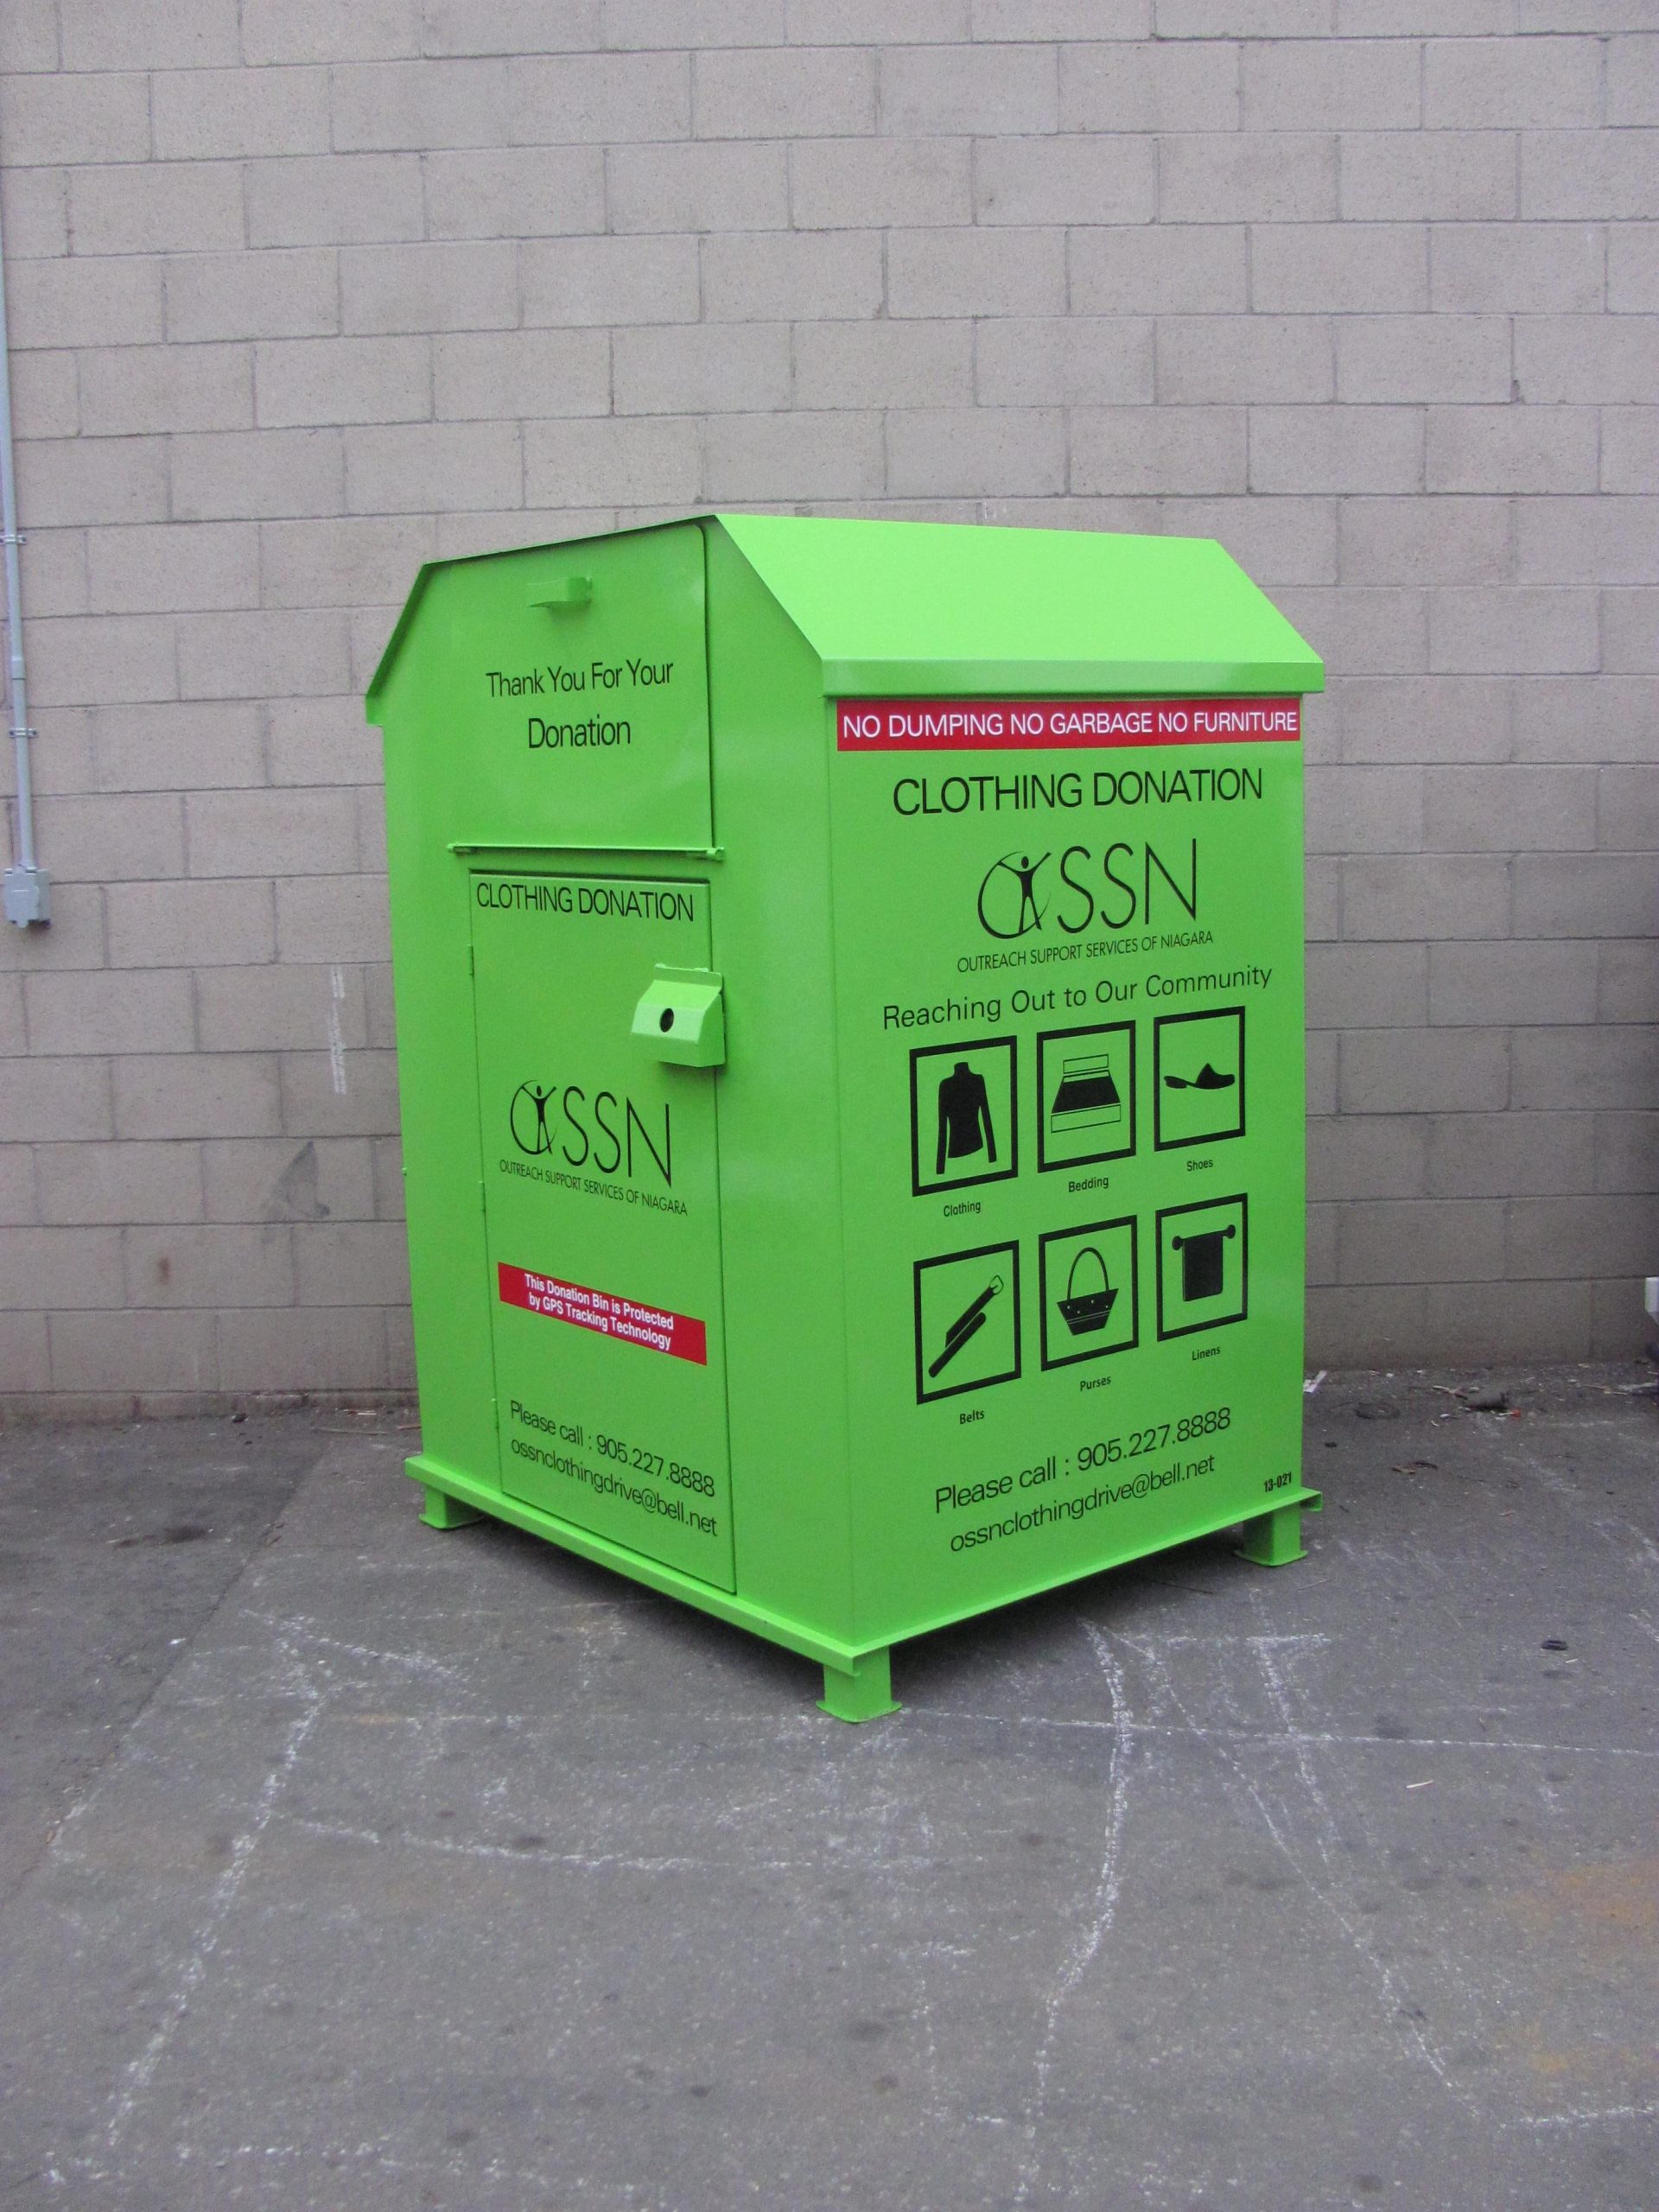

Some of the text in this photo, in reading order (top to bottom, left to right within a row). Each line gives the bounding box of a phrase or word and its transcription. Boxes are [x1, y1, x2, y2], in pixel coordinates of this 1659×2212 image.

[486, 658, 673, 696] Thank You For Your
[529, 714, 631, 748] Donation
[844, 712, 1298, 737] NO DUMPING NO GARBAGE NO FURNITURE
[893, 768, 1262, 815] CLOTHING DONATION
[477, 883, 693, 921] CLOTHING DONATION
[957, 931, 1212, 972] OUTREACH SUPPORT SERVICES OF NIAGARA
[884, 965, 1272, 1030] Reaching Out to Our Community
[1187, 1160, 1213, 1171] Shoes
[500, 1160, 687, 1215] OUTREACH SUPPORT SERVICES OF NIAGARA
[1069, 1178, 1109, 1192] Bedding
[944, 1202, 981, 1217] Clothing
[525, 1274, 674, 1332] This Donation Bin is Protected
[529, 1292, 672, 1352] by GPS Tracking Technology
[1192, 1347, 1220, 1360] Linens
[1080, 1376, 1110, 1391] Purses
[960, 1410, 984, 1424] Belts
[512, 1400, 556, 1435] Please
[560, 1417, 584, 1447] call
[596, 1435, 716, 1499] 905.227.8888
[936, 1476, 1013, 1513] Please
[1020, 1456, 1056, 1487] call
[1077, 1407, 1232, 1473] 905.227.8888
[511, 1440, 718, 1537] ossnclothingdrive@bell.net
[1263, 1471, 1292, 1493] 13-021
[950, 1455, 1214, 1551] ossnclothingdrive@bell.net
